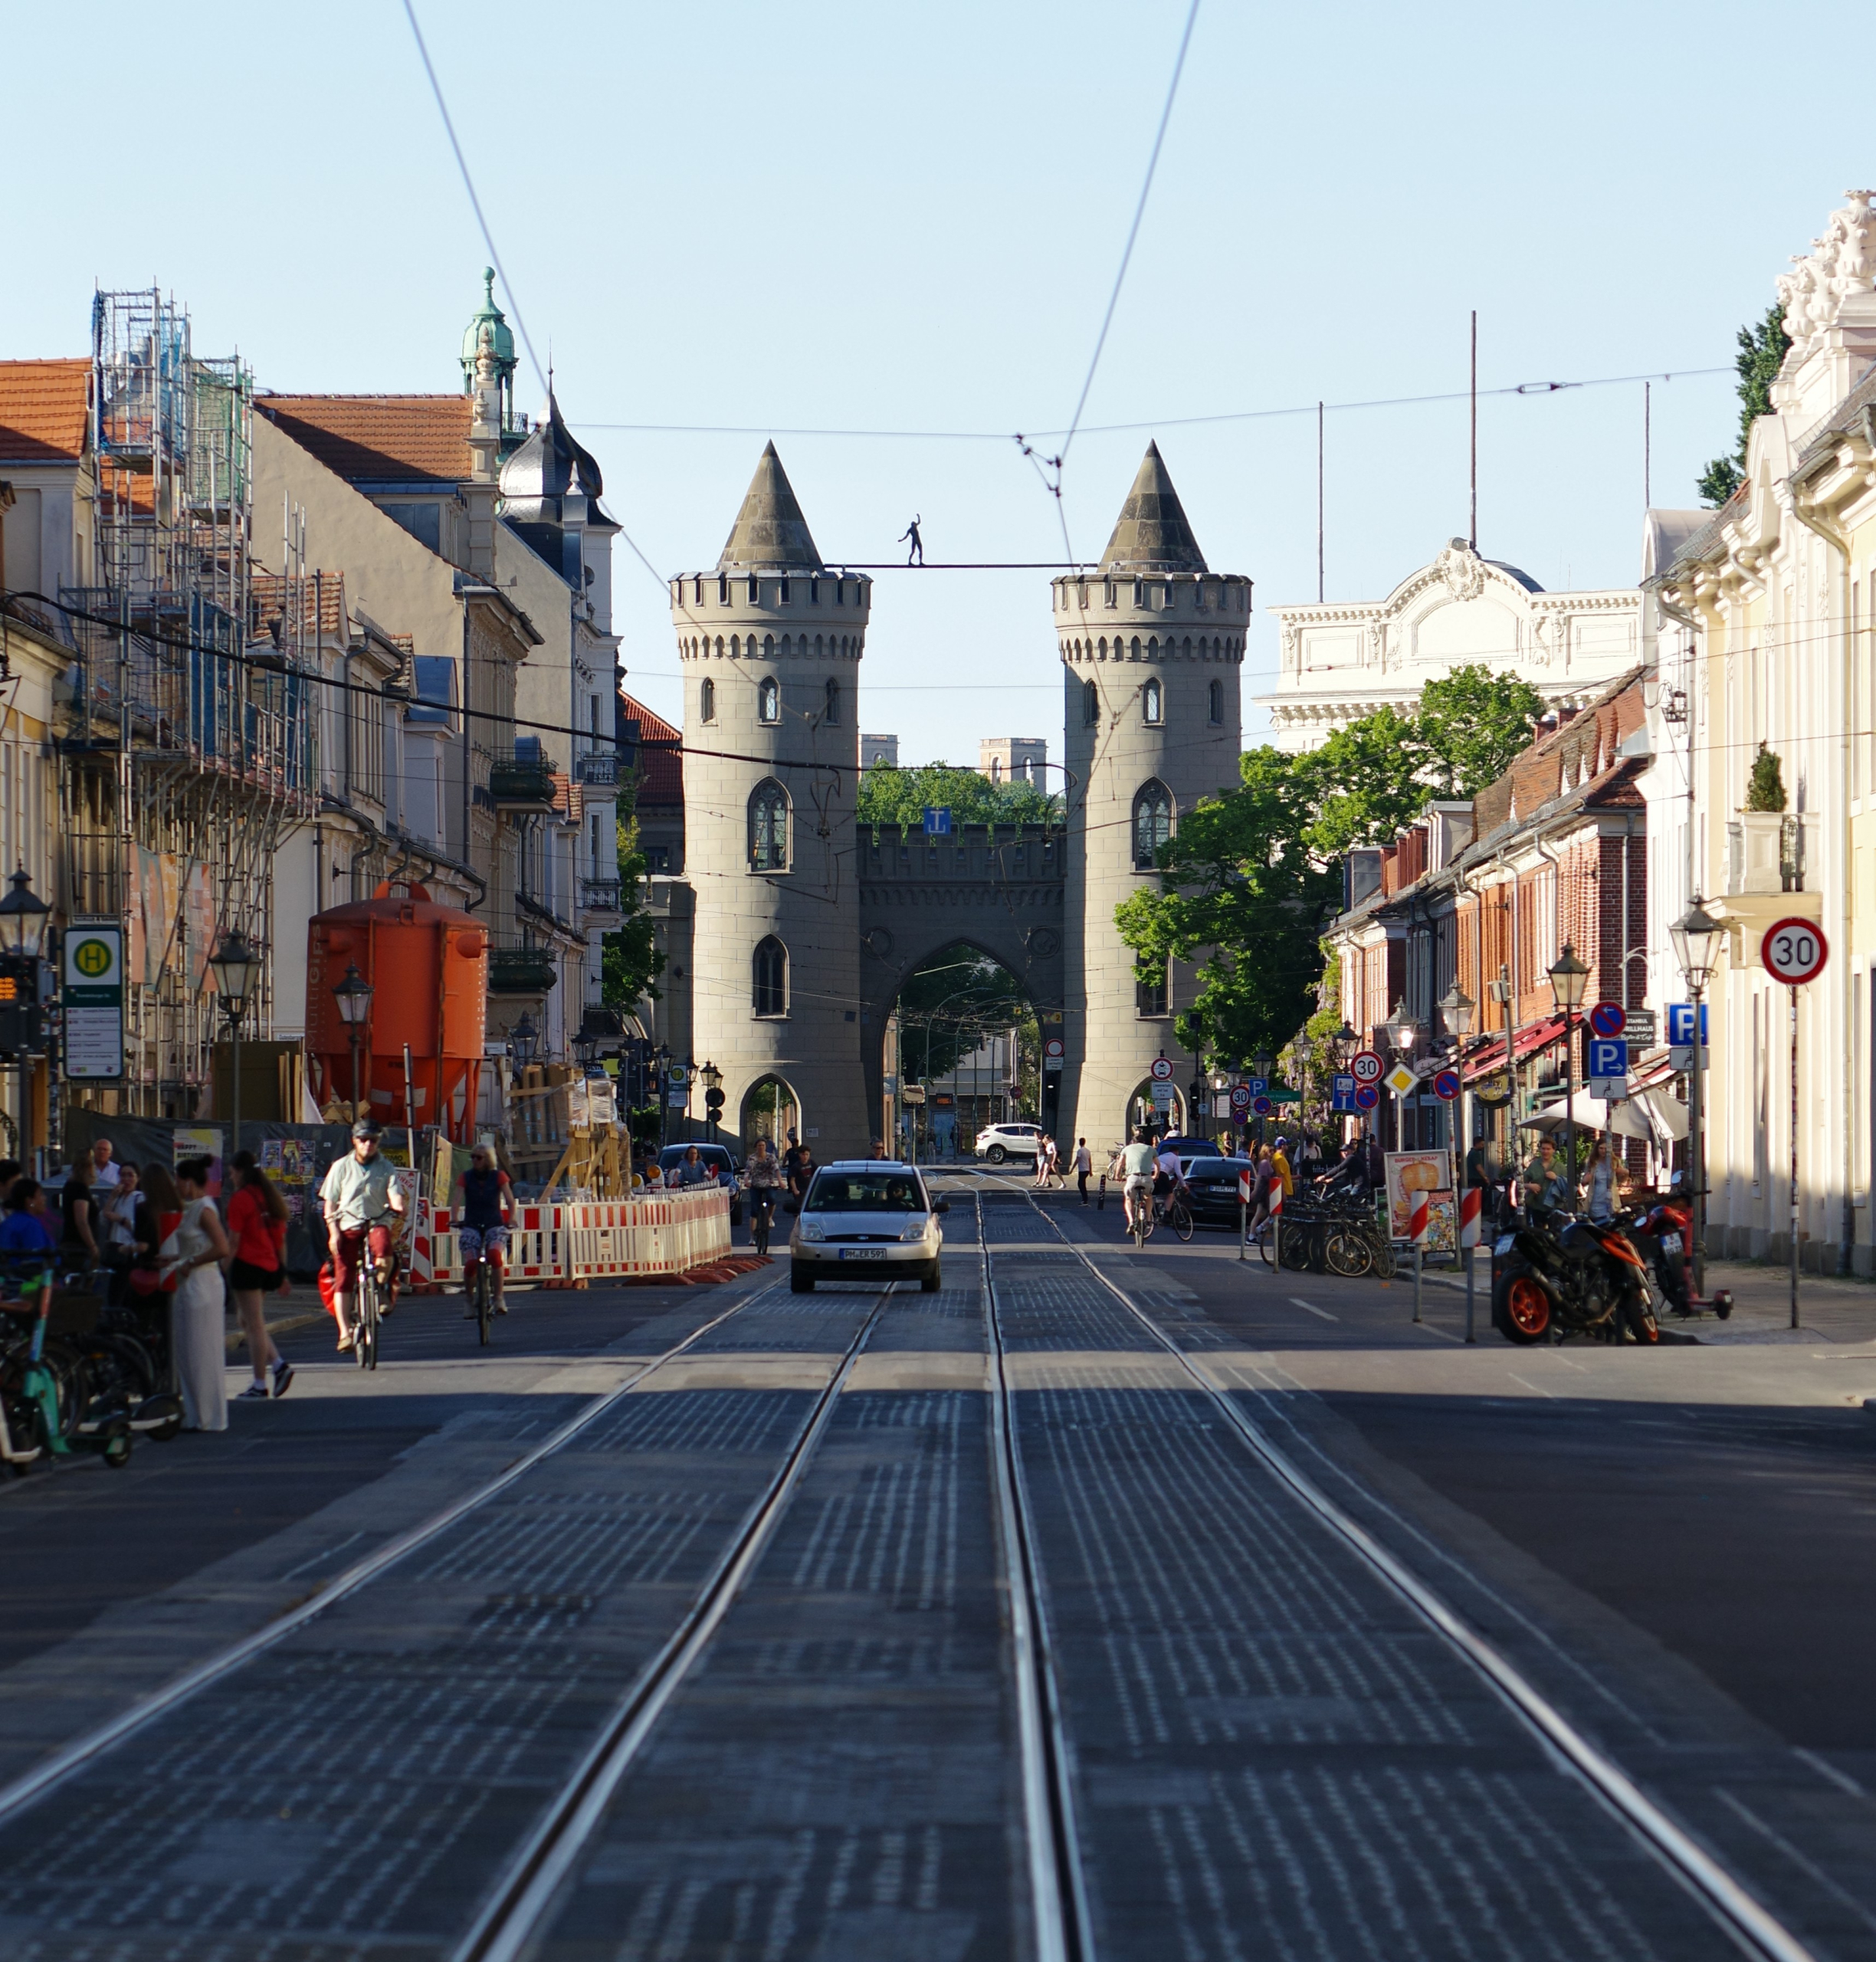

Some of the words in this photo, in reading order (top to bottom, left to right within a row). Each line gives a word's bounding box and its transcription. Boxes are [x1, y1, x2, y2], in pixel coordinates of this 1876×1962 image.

[85, 947, 100, 969] H
[1776, 936, 1814, 966] 30
[1677, 1009, 1694, 1041] P
[1357, 1060, 1376, 1075] 30
[1599, 1045, 1619, 1072] P
[1234, 1091, 1248, 1102] 30
[1253, 1081, 1263, 1095] P
